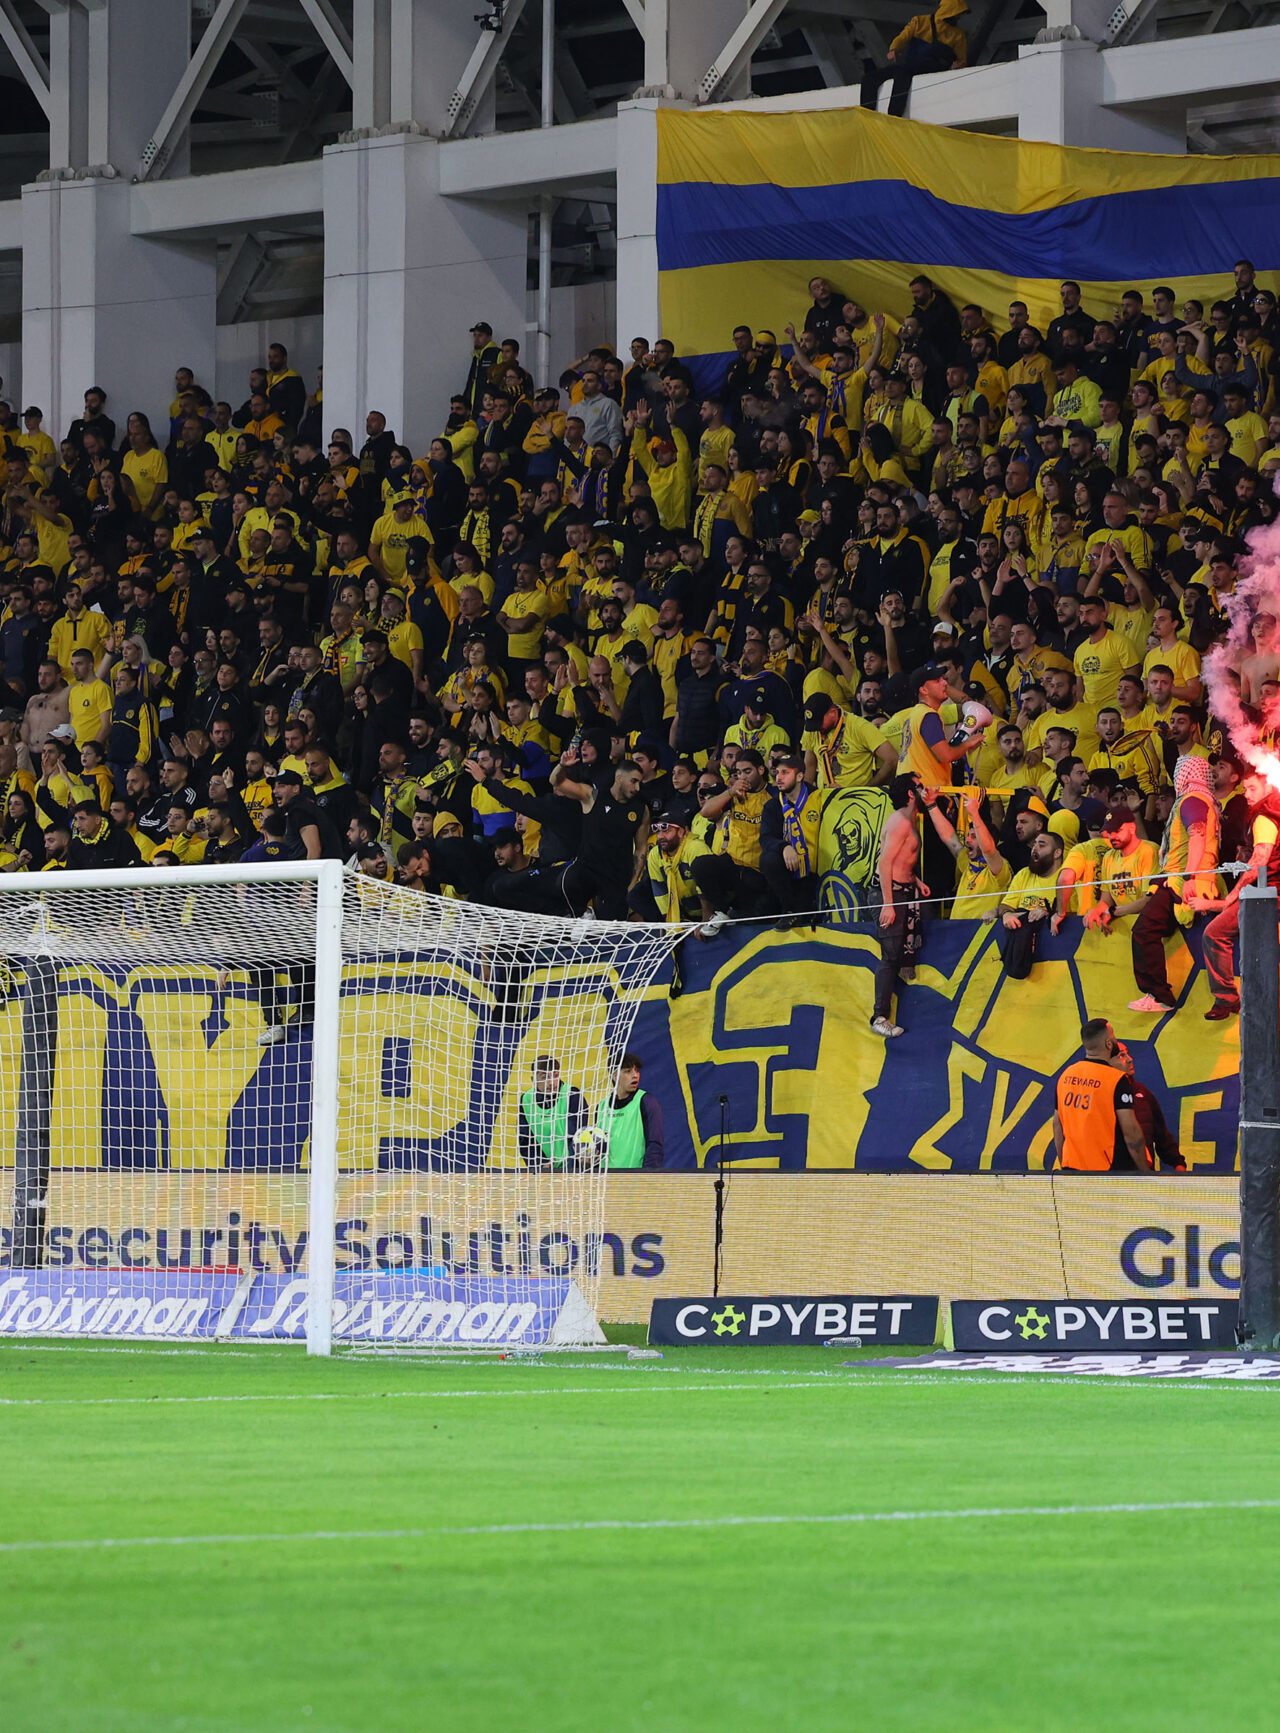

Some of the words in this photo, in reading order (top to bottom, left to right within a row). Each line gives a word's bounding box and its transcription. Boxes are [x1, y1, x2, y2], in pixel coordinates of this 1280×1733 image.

[1064, 1075, 1101, 1089] STEWARD
[1064, 1091, 1091, 1110] 003
[0, 1212, 310, 1274] security
[335, 1214, 665, 1277] Solutions
